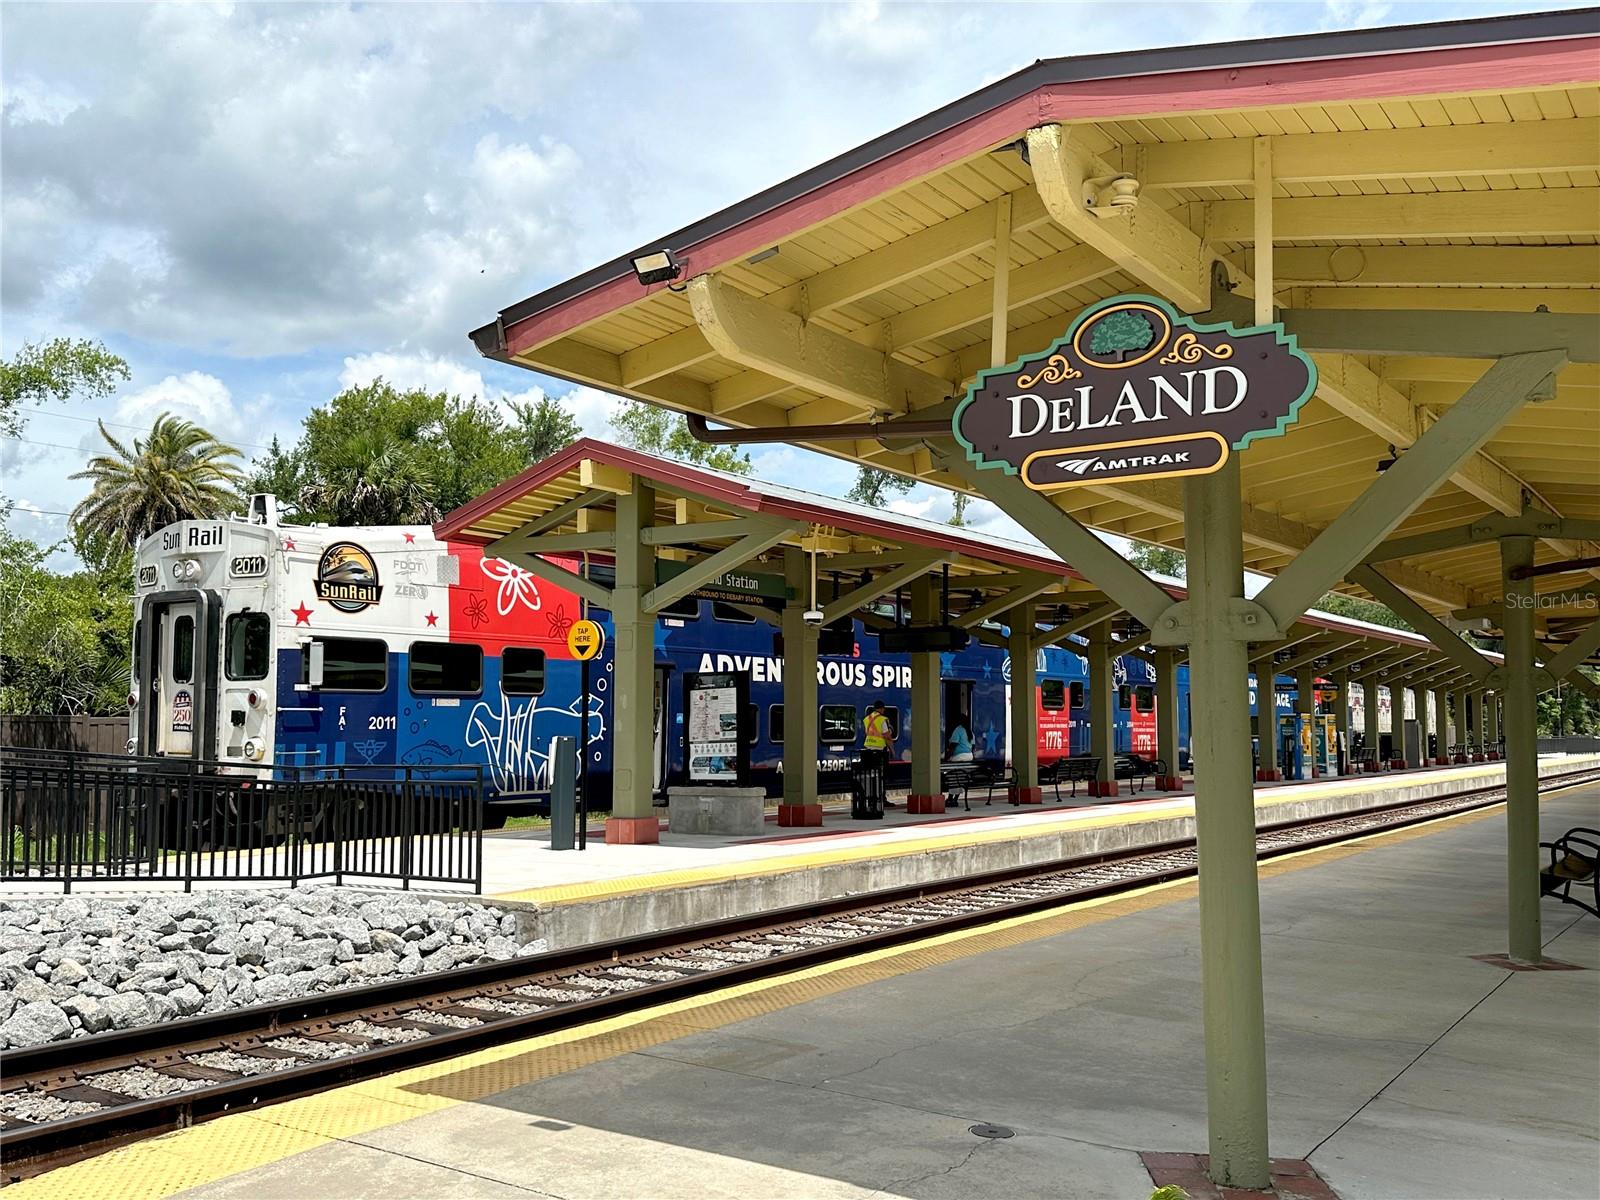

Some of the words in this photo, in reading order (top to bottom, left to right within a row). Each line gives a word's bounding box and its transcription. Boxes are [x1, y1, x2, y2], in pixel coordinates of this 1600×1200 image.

[1092, 451, 1190, 472] AMTRAK
[163, 532, 180, 551] Sun
[188, 526, 223, 546] Rail
[235, 557, 262, 574] 2011
[393, 559, 422, 571] FDOT
[141, 566, 155, 583] 2011
[726, 573, 759, 590] Station
[321, 582, 377, 601] SunRail
[726, 592, 745, 602] DEBARY
[745, 595, 764, 604] STATION
[698, 653, 866, 687] ADVENROUS
[872, 665, 912, 689] SPIR
[1275, 693, 1291, 708] AGE
[173, 709, 191, 722] 250
[368, 716, 397, 730] 2011
[1046, 731, 1062, 750] 1776
[1137, 735, 1151, 751] 1776
